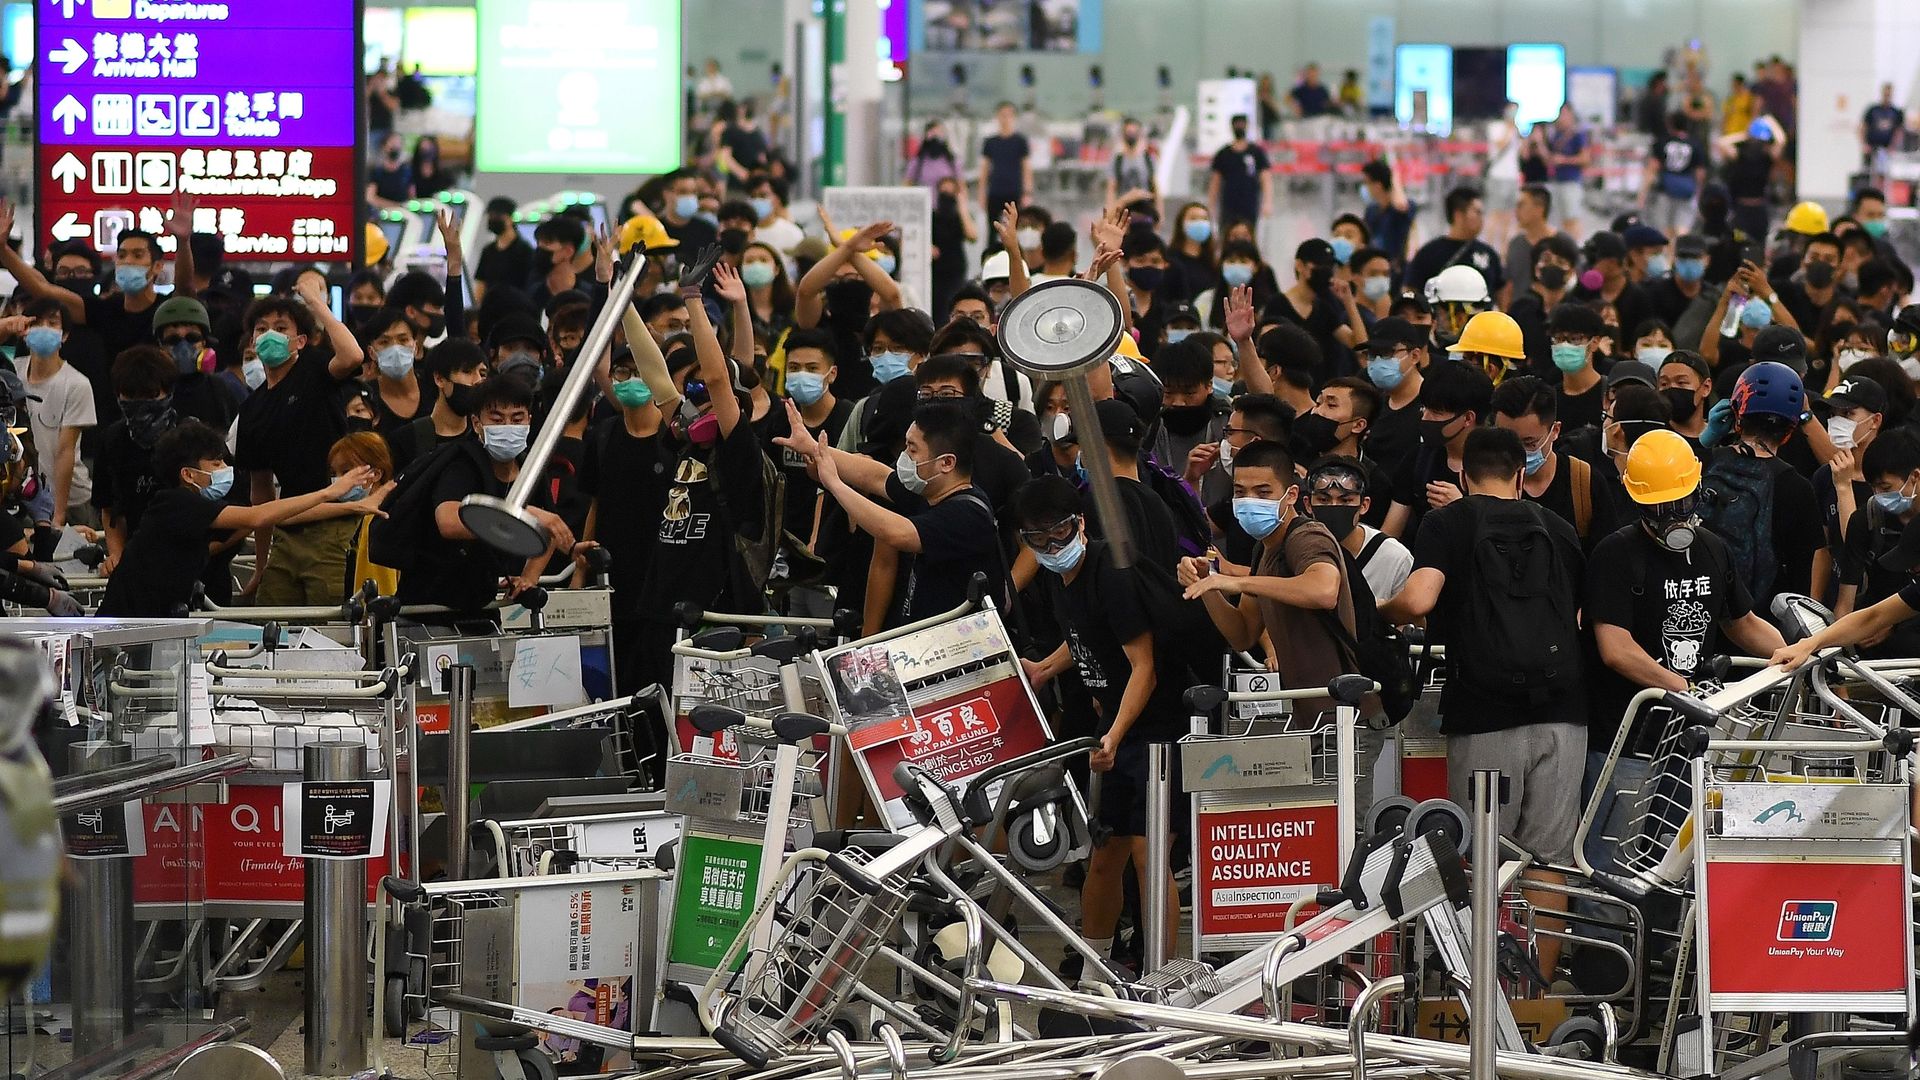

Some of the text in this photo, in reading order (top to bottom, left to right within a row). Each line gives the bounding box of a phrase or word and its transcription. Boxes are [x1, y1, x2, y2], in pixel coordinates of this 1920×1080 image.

[135, 0, 229, 23] Departures
[92, 57, 197, 78] Arrivals Hall
[224, 116, 281, 137] Toilets
[1664, 575, 1712, 600] 依存症
[913, 727, 989, 757] MA PAK LEUNG
[1211, 820, 1316, 842] INTELLIGENT
[1211, 842, 1282, 862] QUALITY
[240, 857, 284, 875] (Formerly
[1211, 861, 1311, 881] ASSURANCE
[702, 866, 746, 890] 用微信支付
[699, 886, 744, 910] 享雙重優惠
[1785, 911, 1831, 925] UnionPay
[1768, 947, 1845, 959] UnionPay Your Way
